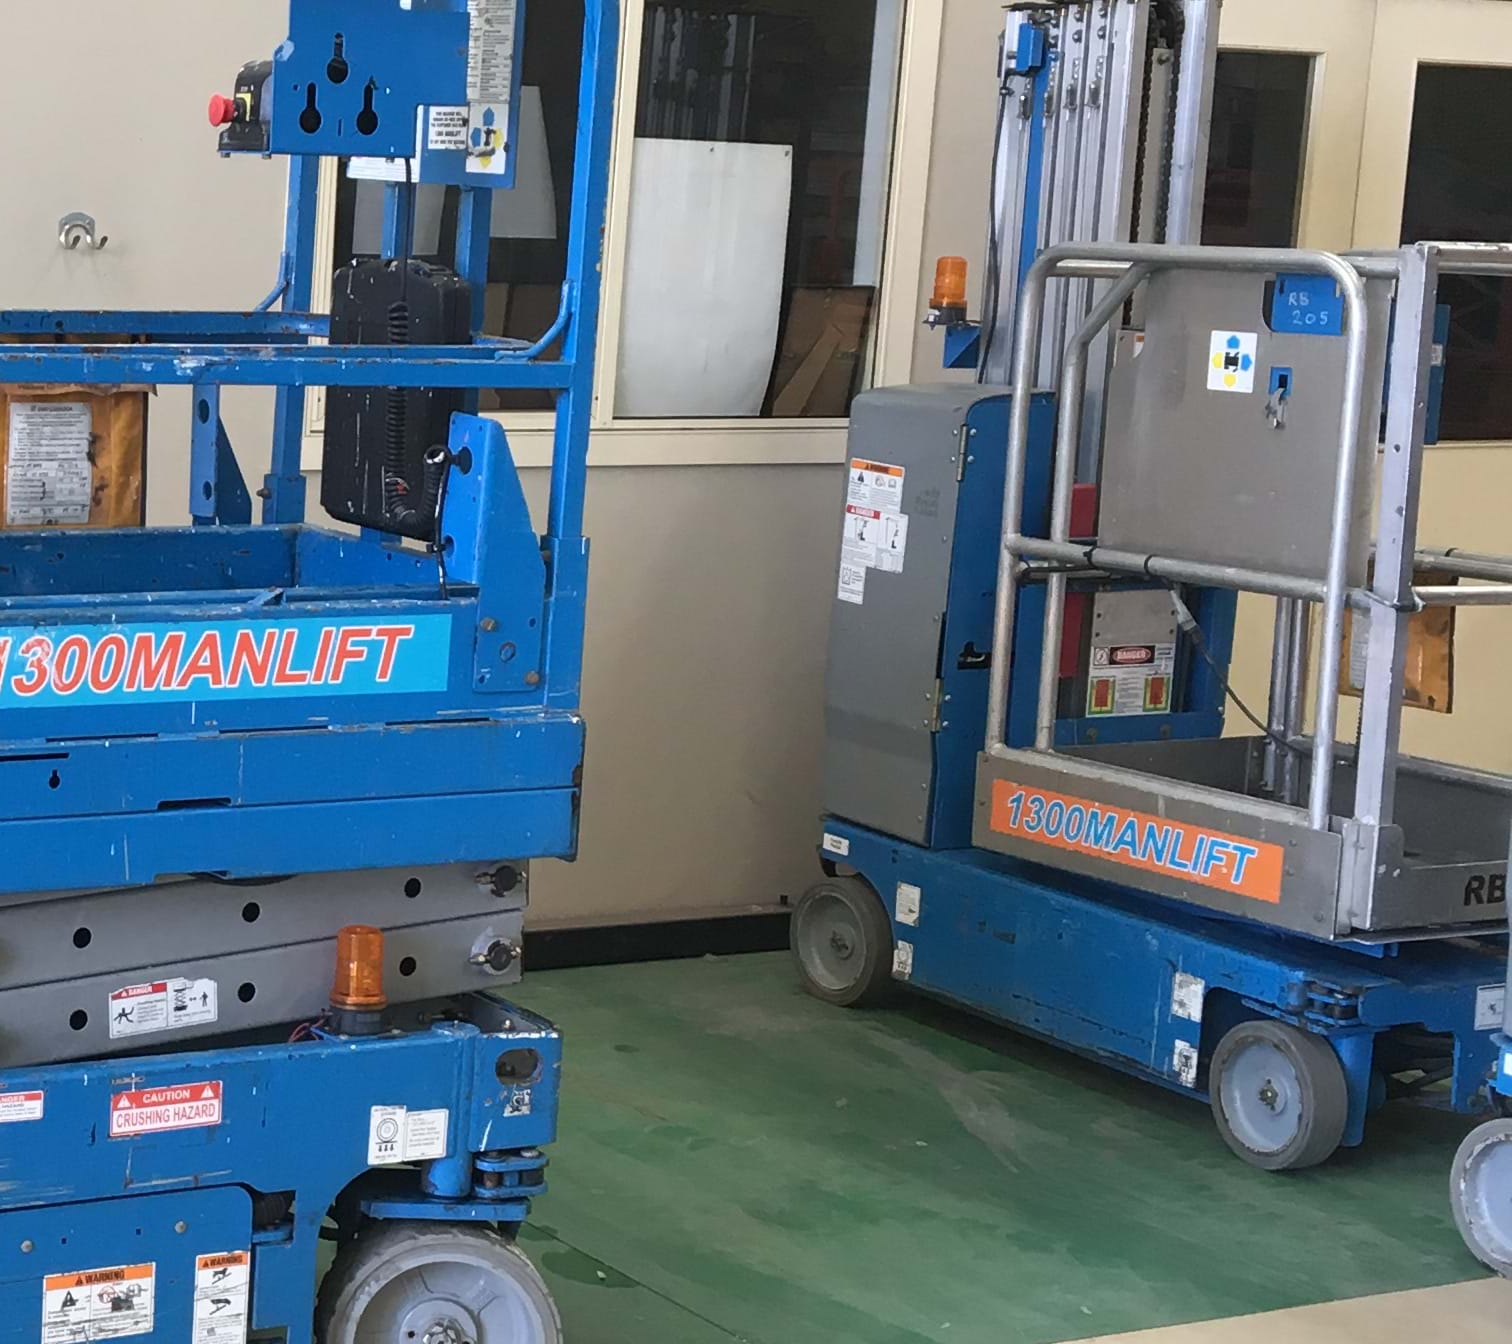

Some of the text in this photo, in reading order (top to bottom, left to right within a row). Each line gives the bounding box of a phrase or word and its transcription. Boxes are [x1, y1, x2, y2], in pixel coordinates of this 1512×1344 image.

[1288, 292, 1309, 306] RB
[1292, 310, 1329, 325] 205
[1117, 650, 1146, 660] DANGER
[1007, 790, 1258, 885] 1300MANLIFT
[143, 1089, 191, 1105] CAUTION
[116, 1103, 216, 1129] CRUSHING HAZARD
[210, 1254, 243, 1267] WARNING
[85, 1270, 125, 1284] WARNING
